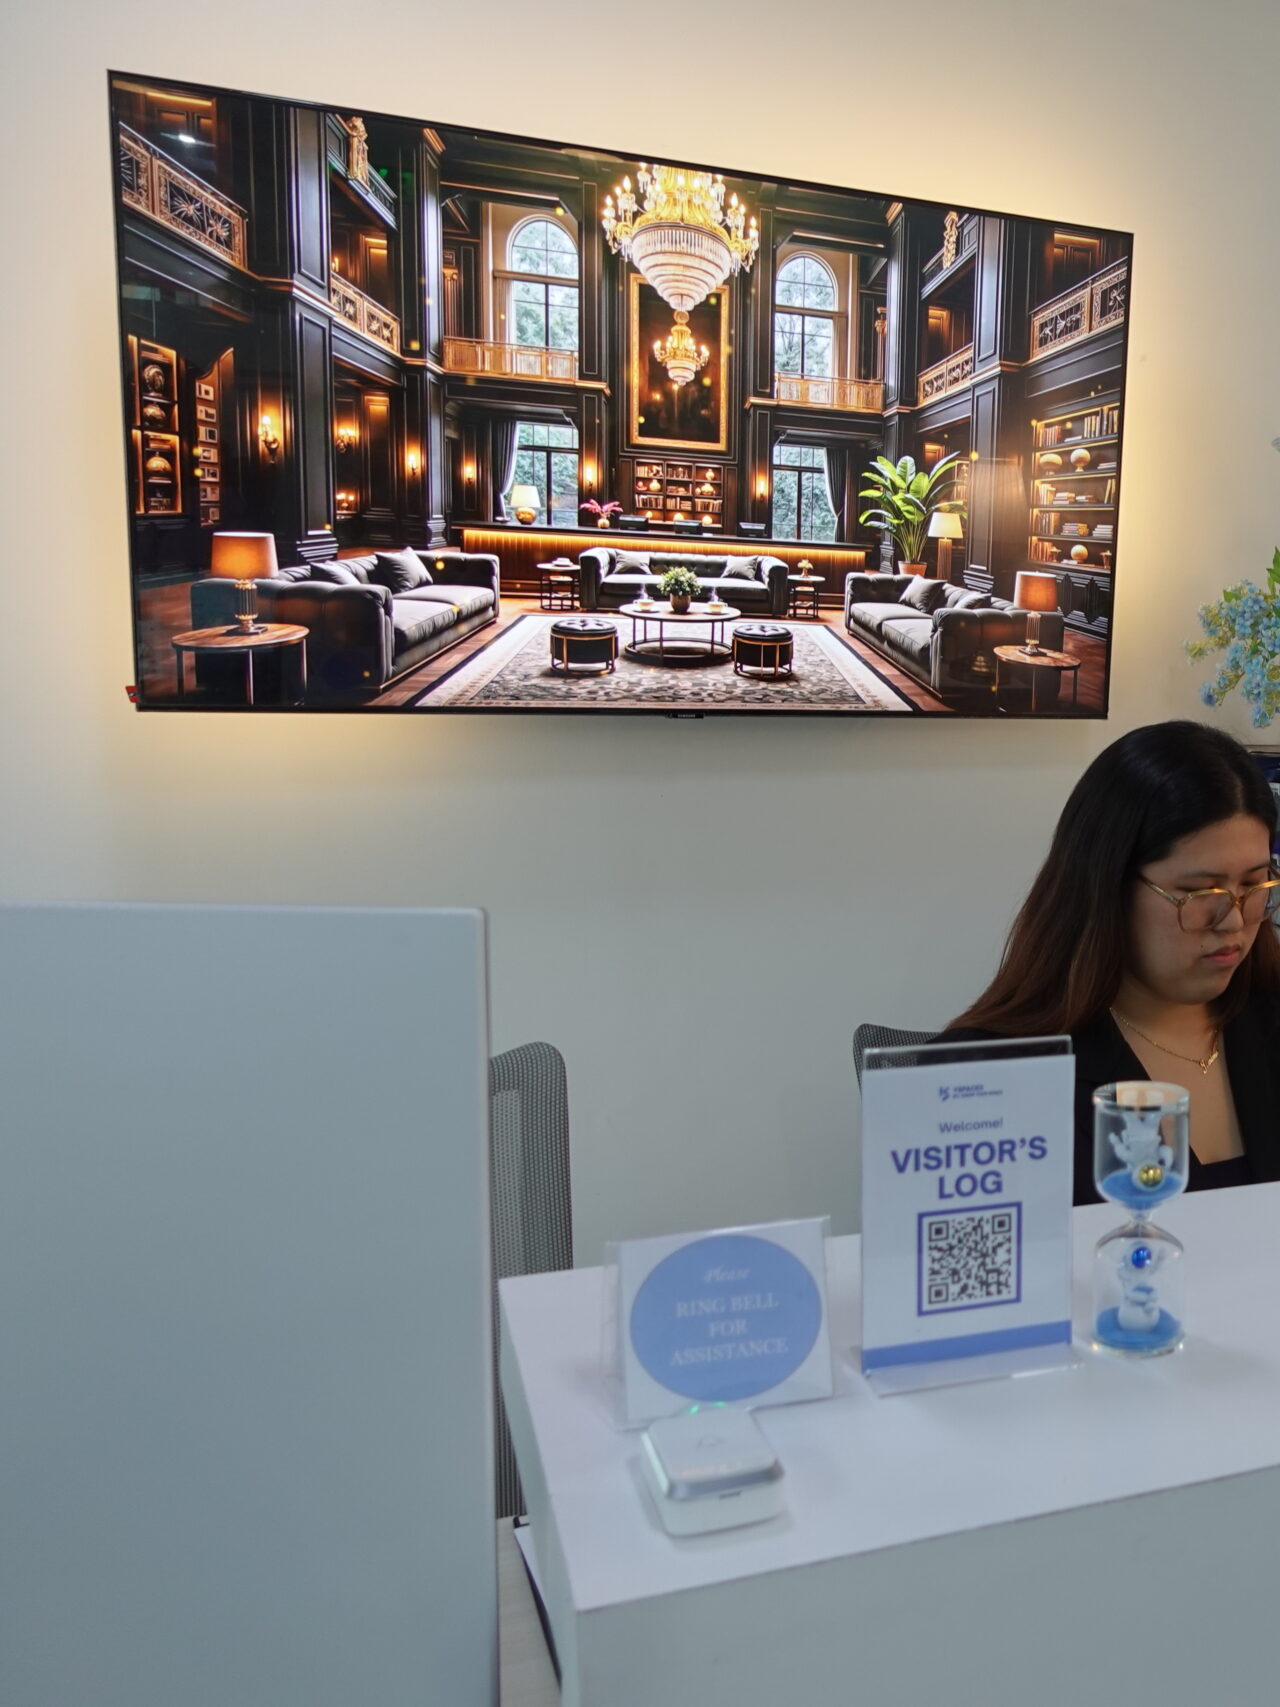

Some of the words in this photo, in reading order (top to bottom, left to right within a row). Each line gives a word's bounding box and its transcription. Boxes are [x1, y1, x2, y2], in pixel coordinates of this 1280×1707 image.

[939, 1117, 1003, 1133] Welcome!
[891, 1135, 1048, 1174] VISITOR'S
[938, 1170, 1003, 1199] LOG
[704, 1265, 750, 1283] Please
[676, 1298, 726, 1318] RING
[731, 1292, 779, 1312] BELL
[709, 1319, 748, 1337] FOR
[670, 1337, 789, 1366] ASSISTANCE
